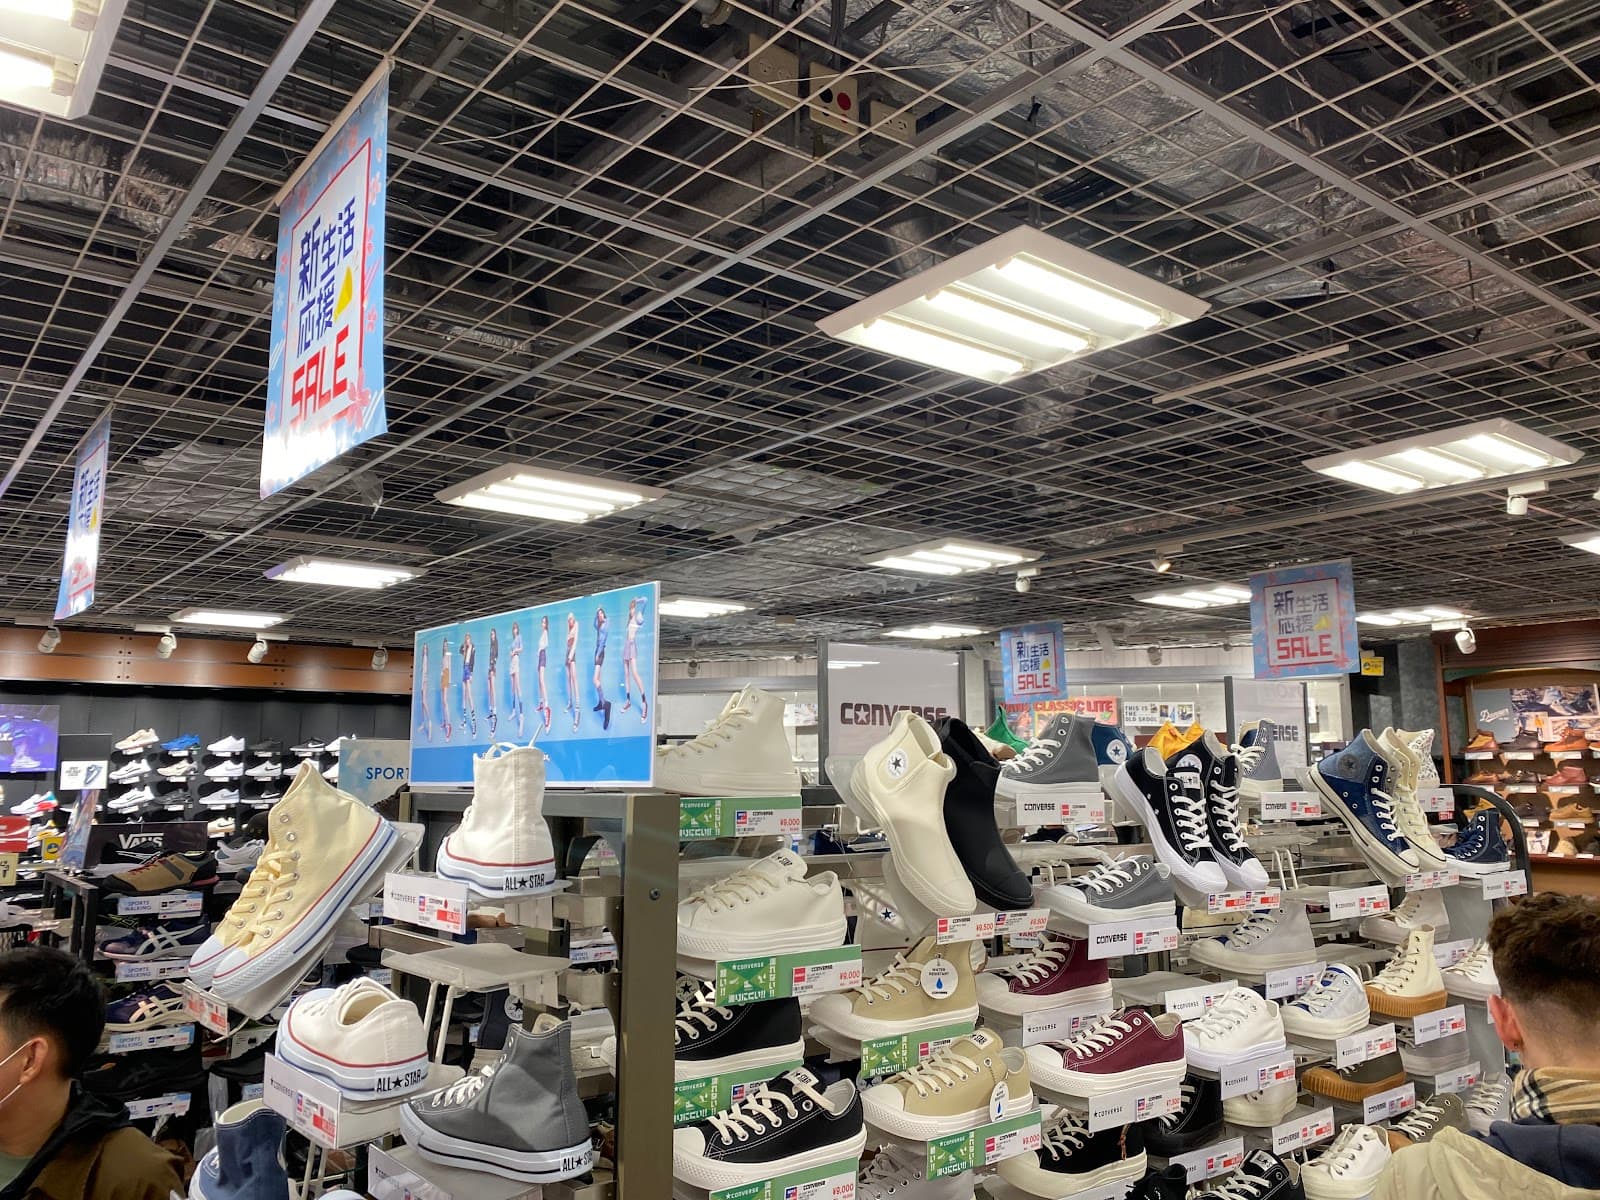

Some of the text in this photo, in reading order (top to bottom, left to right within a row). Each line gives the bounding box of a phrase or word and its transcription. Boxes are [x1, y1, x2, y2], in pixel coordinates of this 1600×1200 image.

[298, 197, 356, 300] 新生活
[298, 275, 335, 358] 応援
[290, 325, 349, 424] SALE
[1273, 590, 1328, 615] 新生活
[1279, 614, 1314, 634] 応援
[1016, 641, 1049, 659] 新生活
[1277, 634, 1333, 660] SALE
[1019, 658, 1040, 673] 応援
[1017, 673, 1050, 690] SALE
[1033, 701, 1085, 712] CLASSIC
[1087, 700, 1113, 712] LITE
[841, 703, 947, 727] CONVRSE
[1023, 802, 1056, 811] CONVERSE
[505, 873, 545, 890] ALL STAR
[1096, 933, 1128, 945] CONVERSE
[736, 962, 764, 971] CONVERSE
[1032, 1023, 1057, 1033] CONVERSE
[376, 1069, 421, 1093] ALL STAR
[1098, 1106, 1123, 1117] CONVERSE
[1278, 1131, 1300, 1146] CONVERSE
[562, 1156, 575, 1172] ALL
[730, 1186, 759, 1199] CONVERSE
